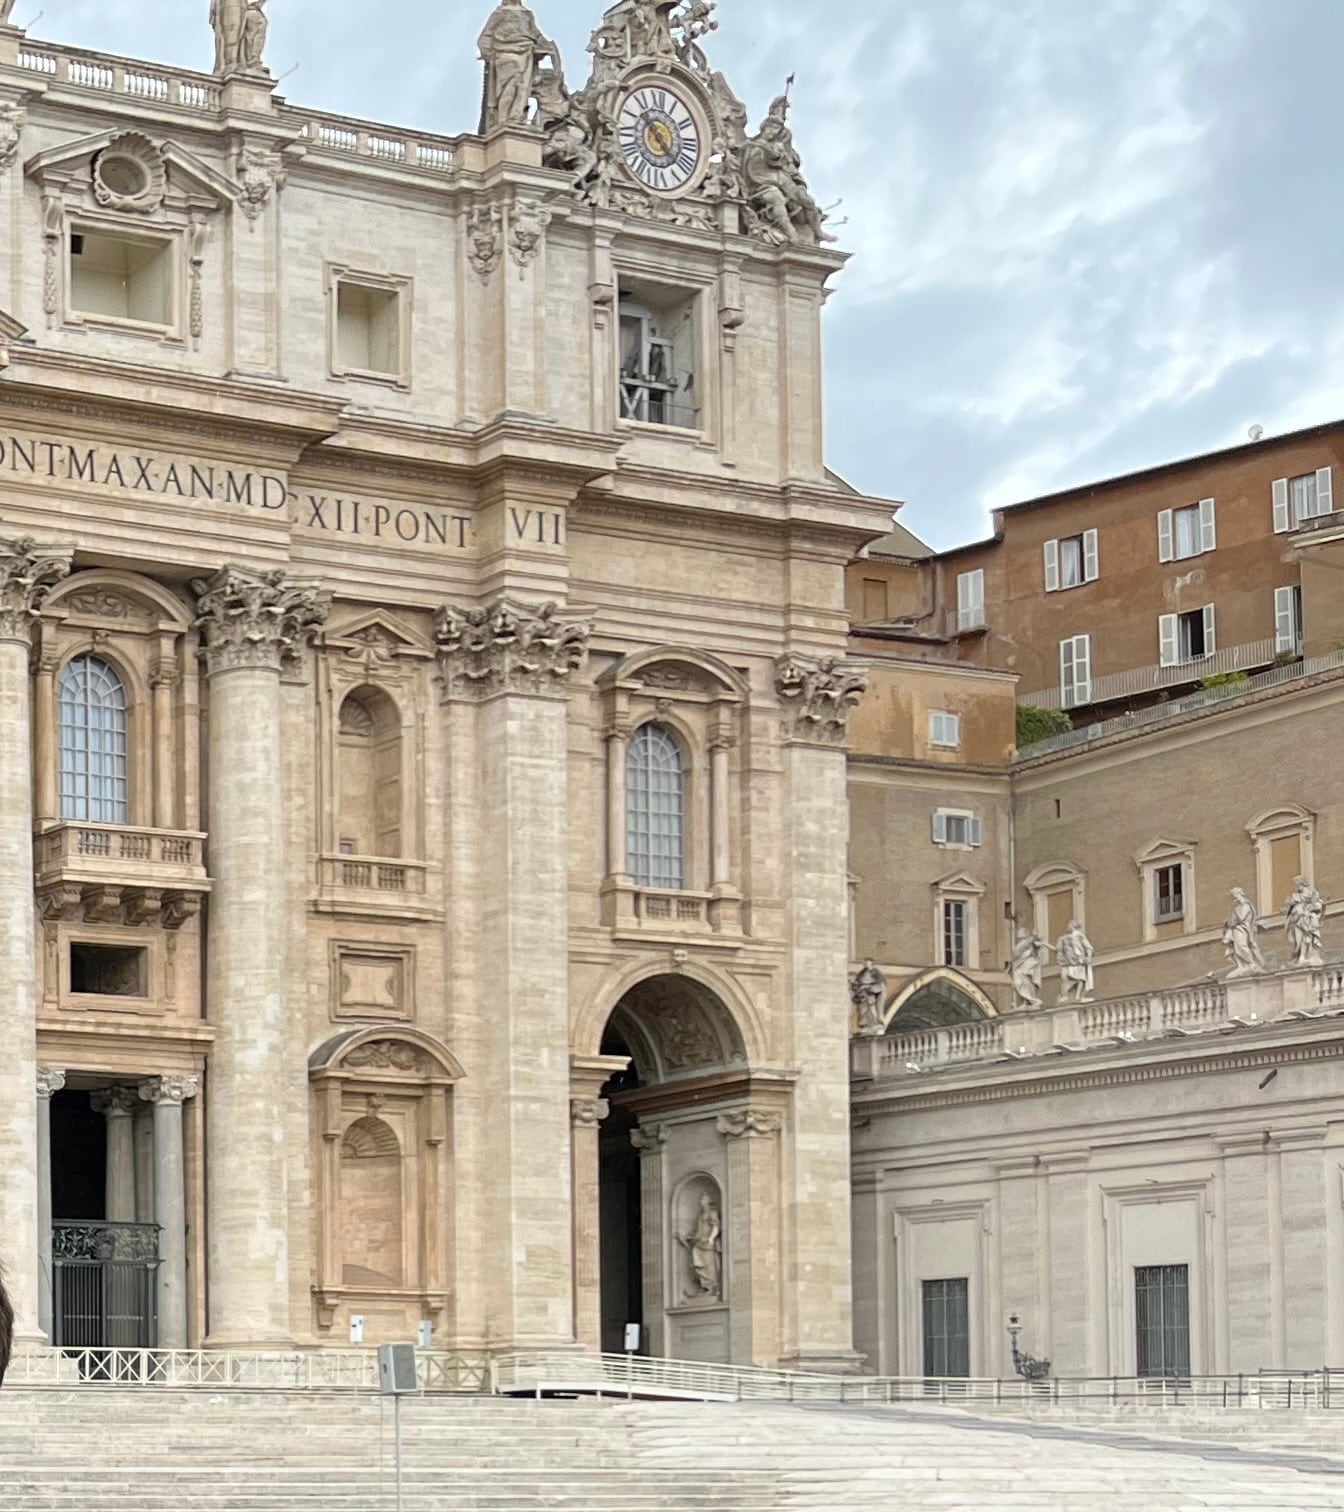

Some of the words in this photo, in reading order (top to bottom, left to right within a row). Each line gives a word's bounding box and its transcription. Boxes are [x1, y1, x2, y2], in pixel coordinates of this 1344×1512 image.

[65, 445, 157, 491] MAX
[373, 504, 472, 548] PONT
[509, 506, 565, 545] VII
